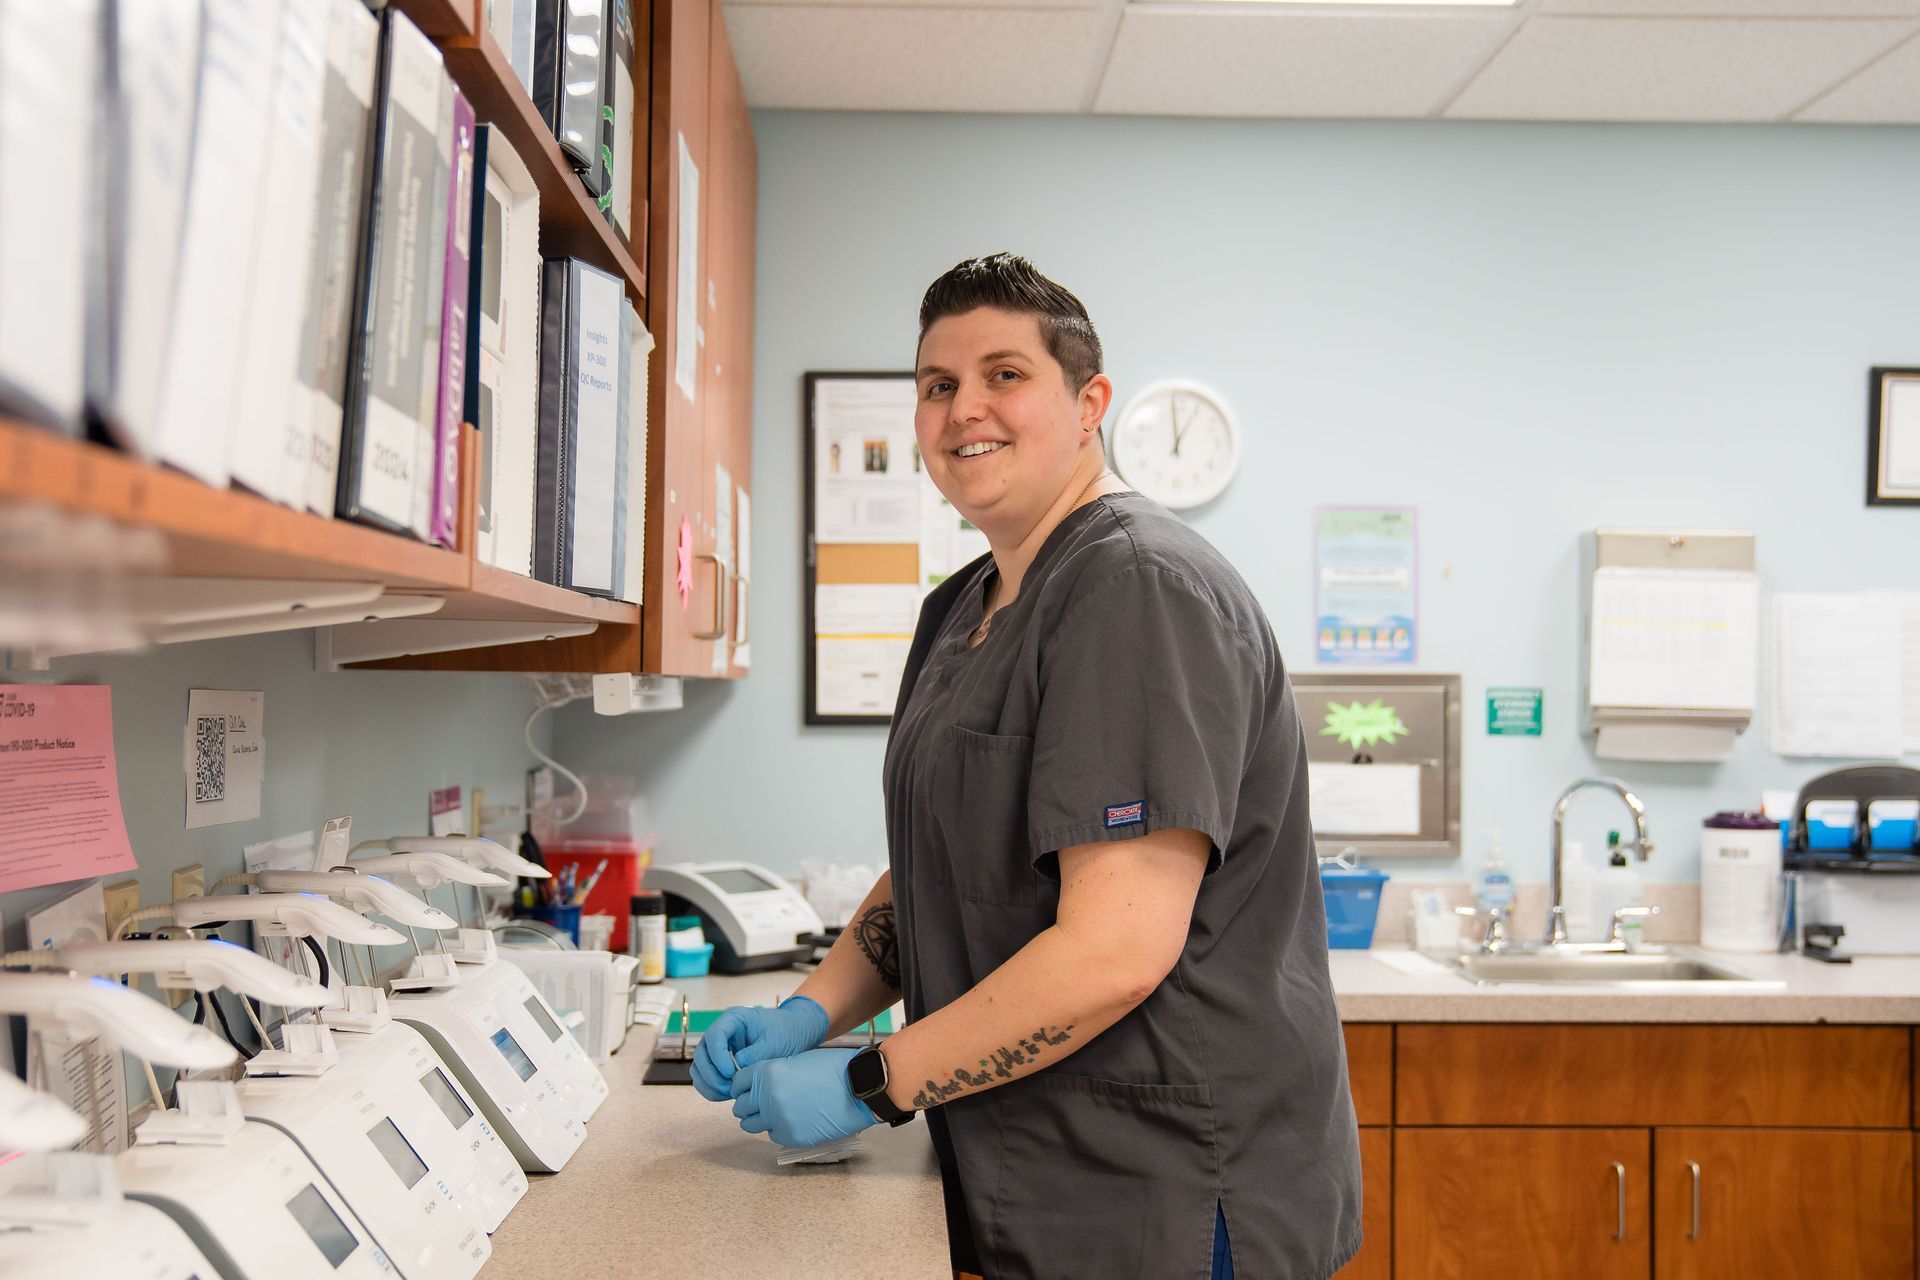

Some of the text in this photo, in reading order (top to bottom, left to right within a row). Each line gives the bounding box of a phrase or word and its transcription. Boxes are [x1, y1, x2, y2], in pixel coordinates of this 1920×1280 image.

[586, 328, 608, 345] Insights
[586, 351, 607, 367] XP-300
[580, 372, 612, 392] QC Reports
[4, 702, 35, 718] COVID-19
[34, 738, 55, 750] Product
[56, 737, 76, 749] Notice
[1109, 807, 1138, 817] CHEROKEE
[1111, 815, 1138, 823] WORKWEAR
[926, 1080, 963, 1101] Best
